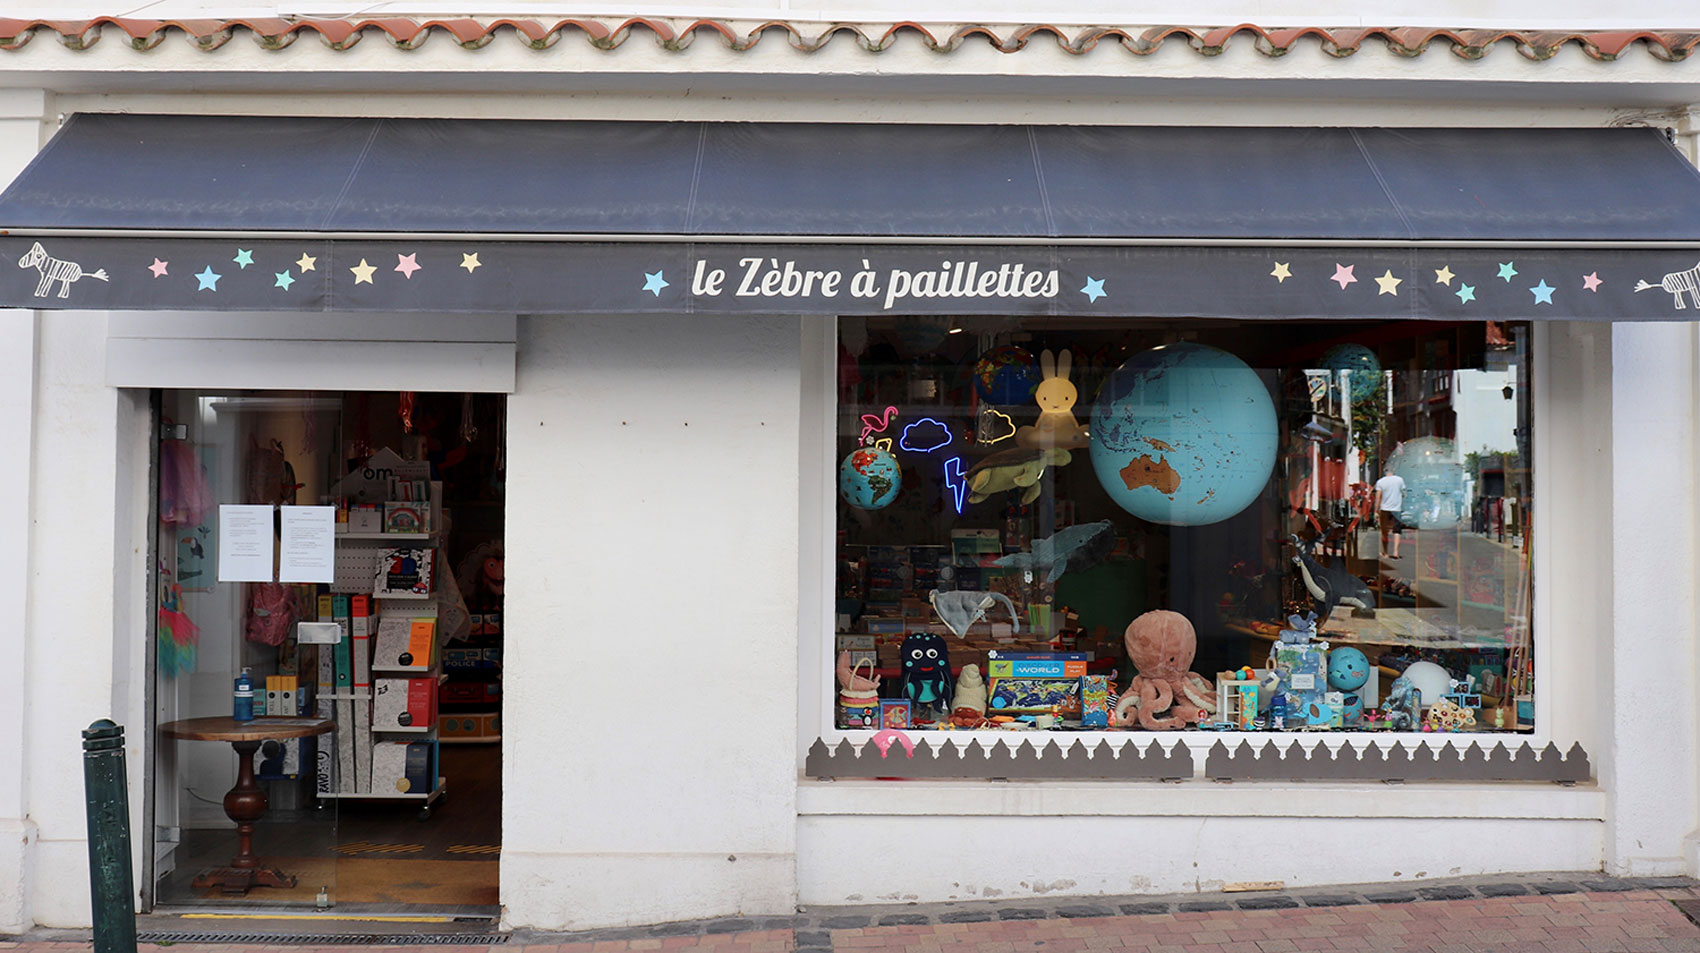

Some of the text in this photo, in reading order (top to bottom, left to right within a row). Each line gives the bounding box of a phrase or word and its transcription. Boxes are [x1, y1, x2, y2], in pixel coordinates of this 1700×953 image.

[691, 257, 1060, 310] le Zèbre à paillettes
